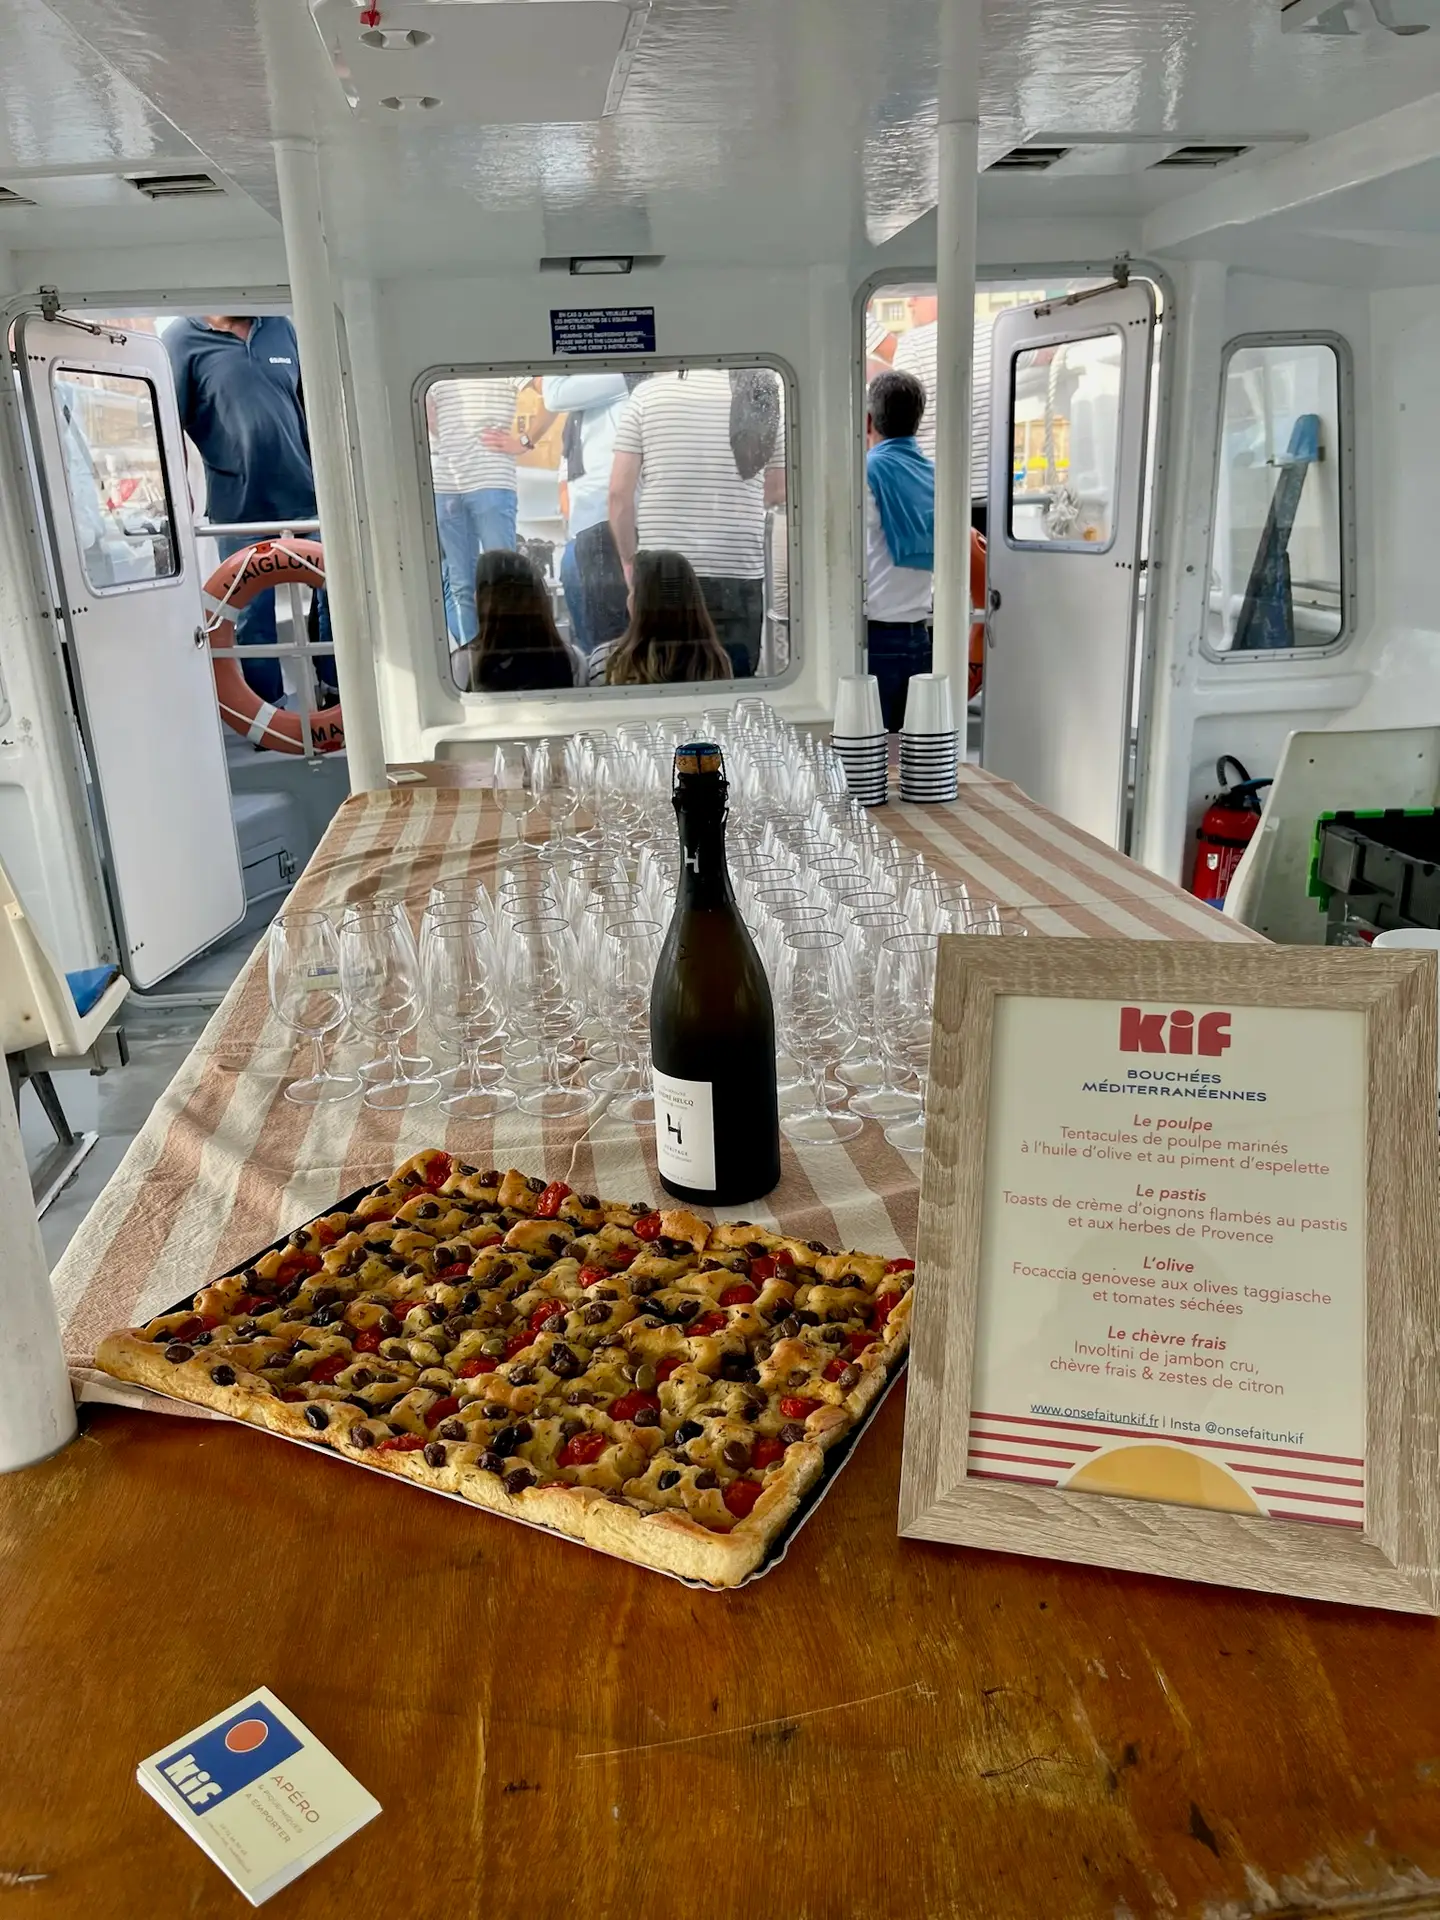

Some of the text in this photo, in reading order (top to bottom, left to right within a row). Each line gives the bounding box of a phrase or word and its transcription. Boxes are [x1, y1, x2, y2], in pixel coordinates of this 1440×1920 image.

[1081, 1078, 1267, 1102] MÉDITERRANÉENNES
[1127, 1068, 1222, 1084] BOUCHÉES
[1133, 1114, 1213, 1134] Le poulpe
[1021, 1140, 1029, 1153] à
[1137, 1151, 1153, 1163] et
[1157, 1154, 1175, 1164] au
[1180, 1153, 1235, 1169] piment
[1059, 1126, 1288, 1155] Tentacules de poulpe marinés
[1136, 1184, 1207, 1202] Le pastis
[1003, 1190, 1048, 1207] Toasts
[1052, 1194, 1072, 1209] de
[1076, 1197, 1123, 1213] crème
[1209, 1206, 1272, 1226] flambés
[1276, 1216, 1295, 1227] au
[1301, 1218, 1348, 1233] pastis
[1068, 1216, 1274, 1244] et aux herbes de Provence
[1013, 1261, 1332, 1305] Focaccia genovese aux olives taggiasche
[1092, 1290, 1243, 1315] et tomates séchées
[1107, 1325, 1227, 1351] Le chèvre frais
[1075, 1340, 1259, 1375] Involtini de jambon cru,
[1050, 1356, 1284, 1395] chèvre frais & zestes de citron
[1029, 1404, 1160, 1429] www.onsefaitunkif.fr
[1170, 1417, 1201, 1432] Insta
[1205, 1421, 1304, 1445] @onsefaitunkif
[270, 1775, 320, 1823] APÉRO
[251, 1798, 291, 1844] EMPORTER
